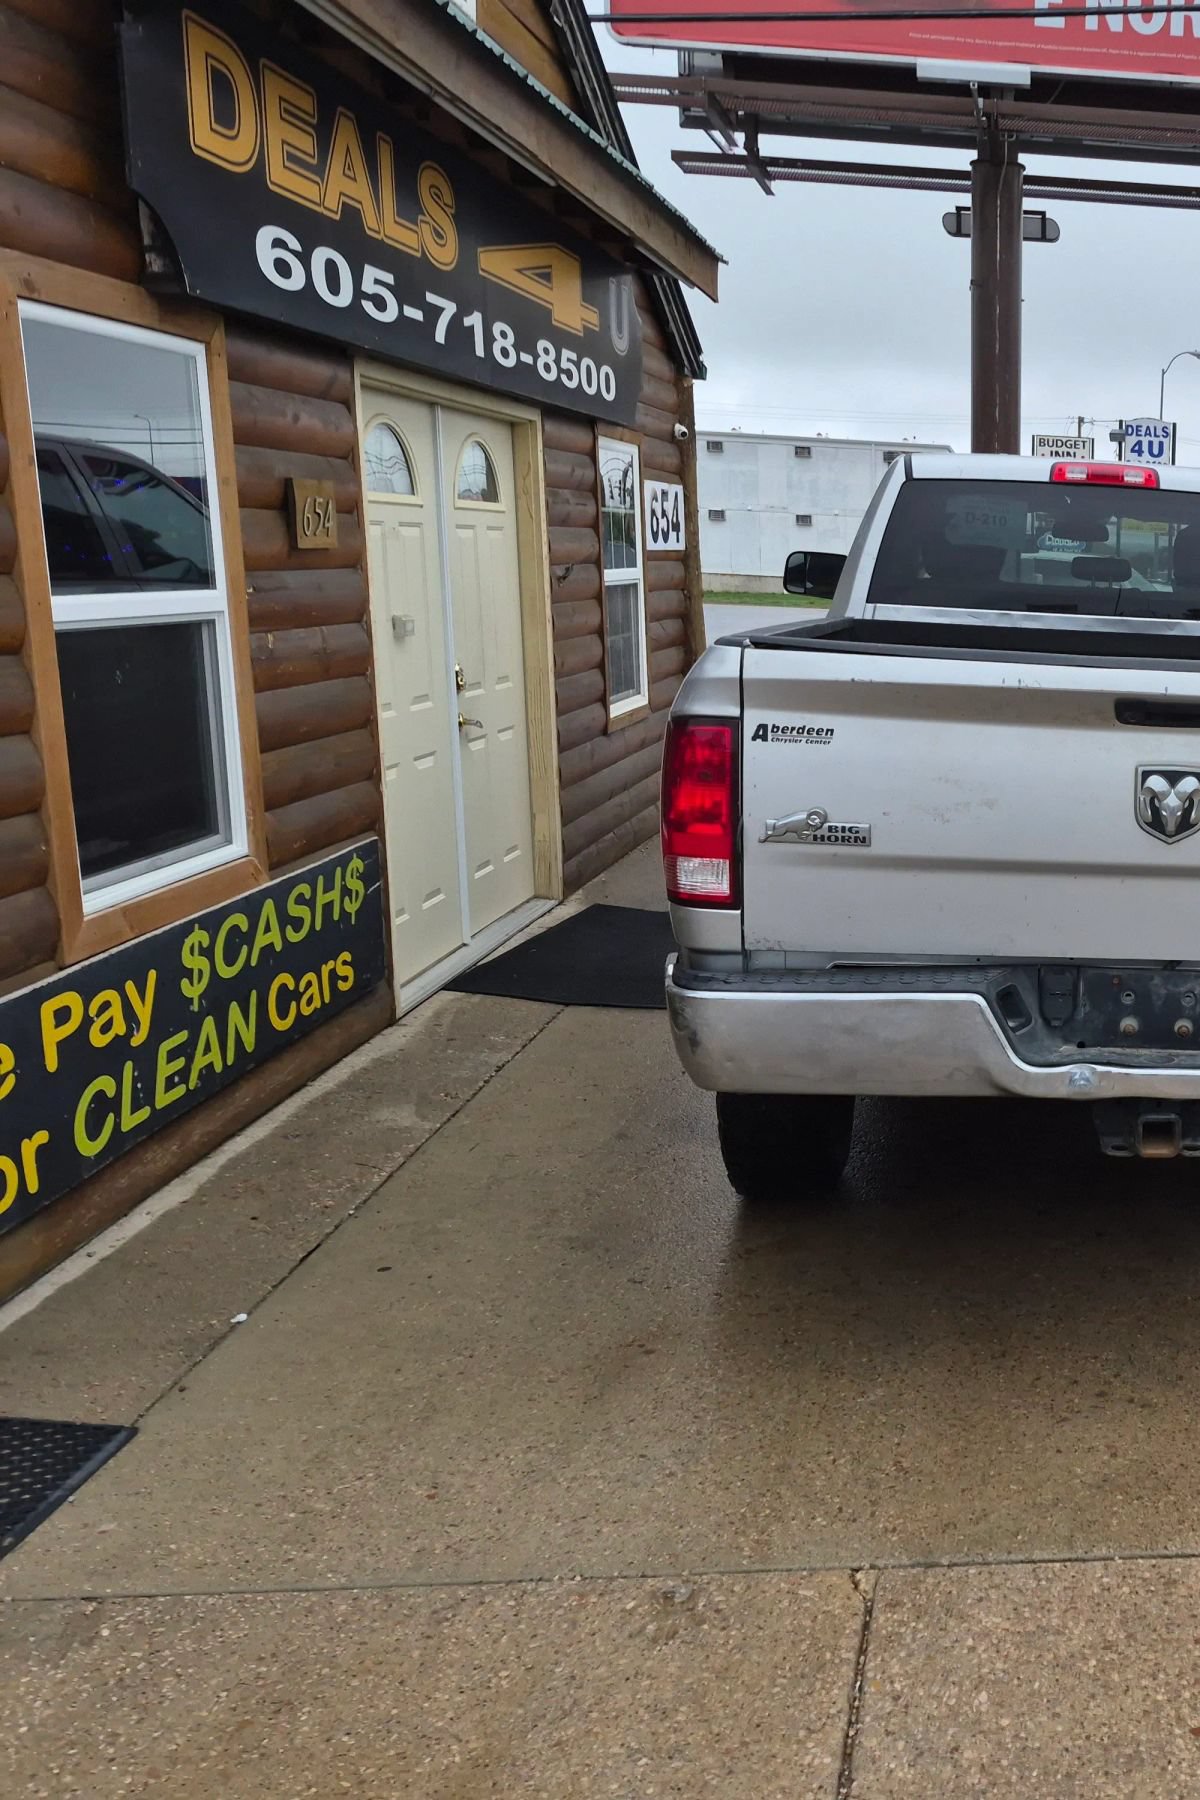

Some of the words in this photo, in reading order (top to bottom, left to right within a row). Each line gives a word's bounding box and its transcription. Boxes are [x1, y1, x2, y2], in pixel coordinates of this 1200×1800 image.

[181, 9, 459, 271] DEALS
[477, 243, 600, 336] 4
[608, 274, 631, 356] U
[255, 225, 617, 402] 605-718-8500
[1038, 437, 1088, 450] BUDGET
[1126, 424, 1170, 439] DEALS
[1130, 439, 1165, 458] 4U
[302, 496, 334, 538] 654
[649, 489, 681, 545] 654
[751, 723, 835, 742] Aberdeen
[812, 834, 867, 844] HORN
[827, 825, 860, 834] BIG
[40, 969, 157, 1073] Pay
[180, 853, 365, 1012] $CASH$
[74, 989, 258, 1158] CLEAN
[268, 951, 355, 1032] Cars
